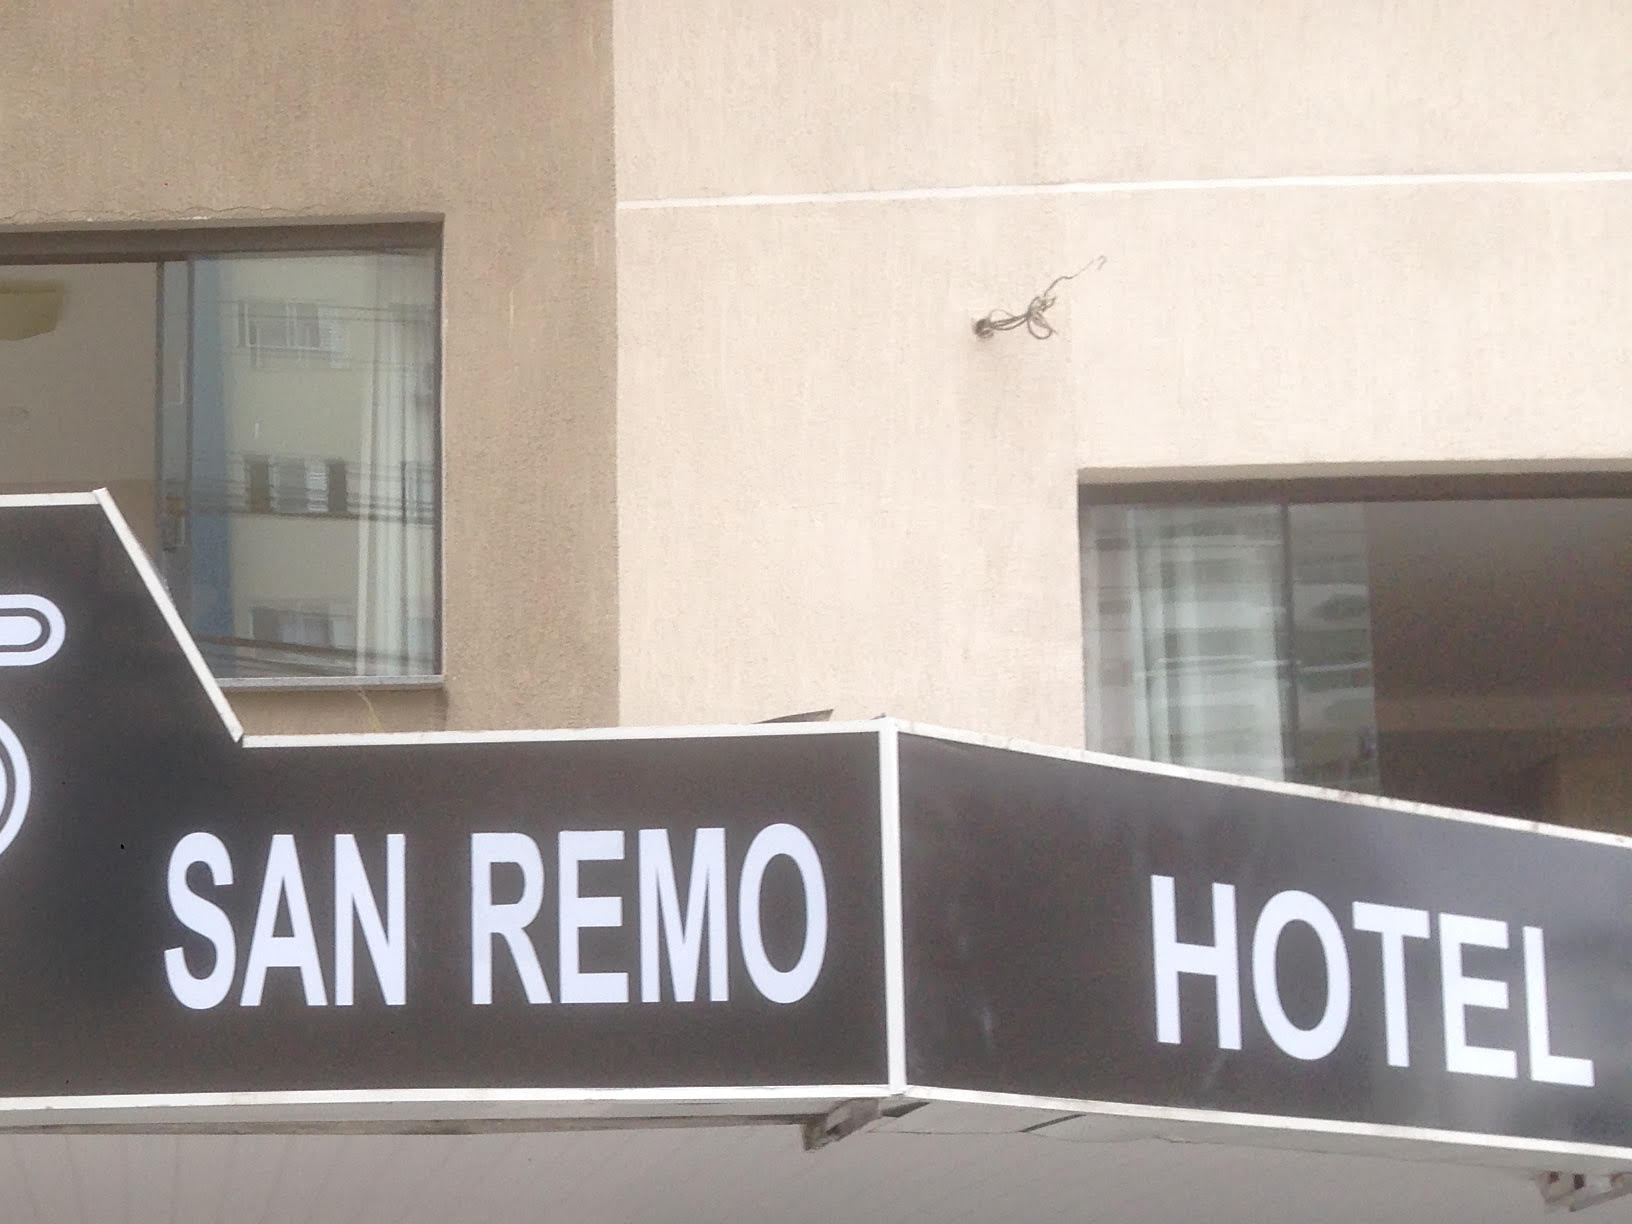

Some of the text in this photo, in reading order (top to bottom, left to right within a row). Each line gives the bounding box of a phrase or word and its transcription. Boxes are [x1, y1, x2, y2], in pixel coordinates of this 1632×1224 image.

[164, 823, 828, 1009] SAN REMO
[1151, 874, 1595, 1087] HOTEL
